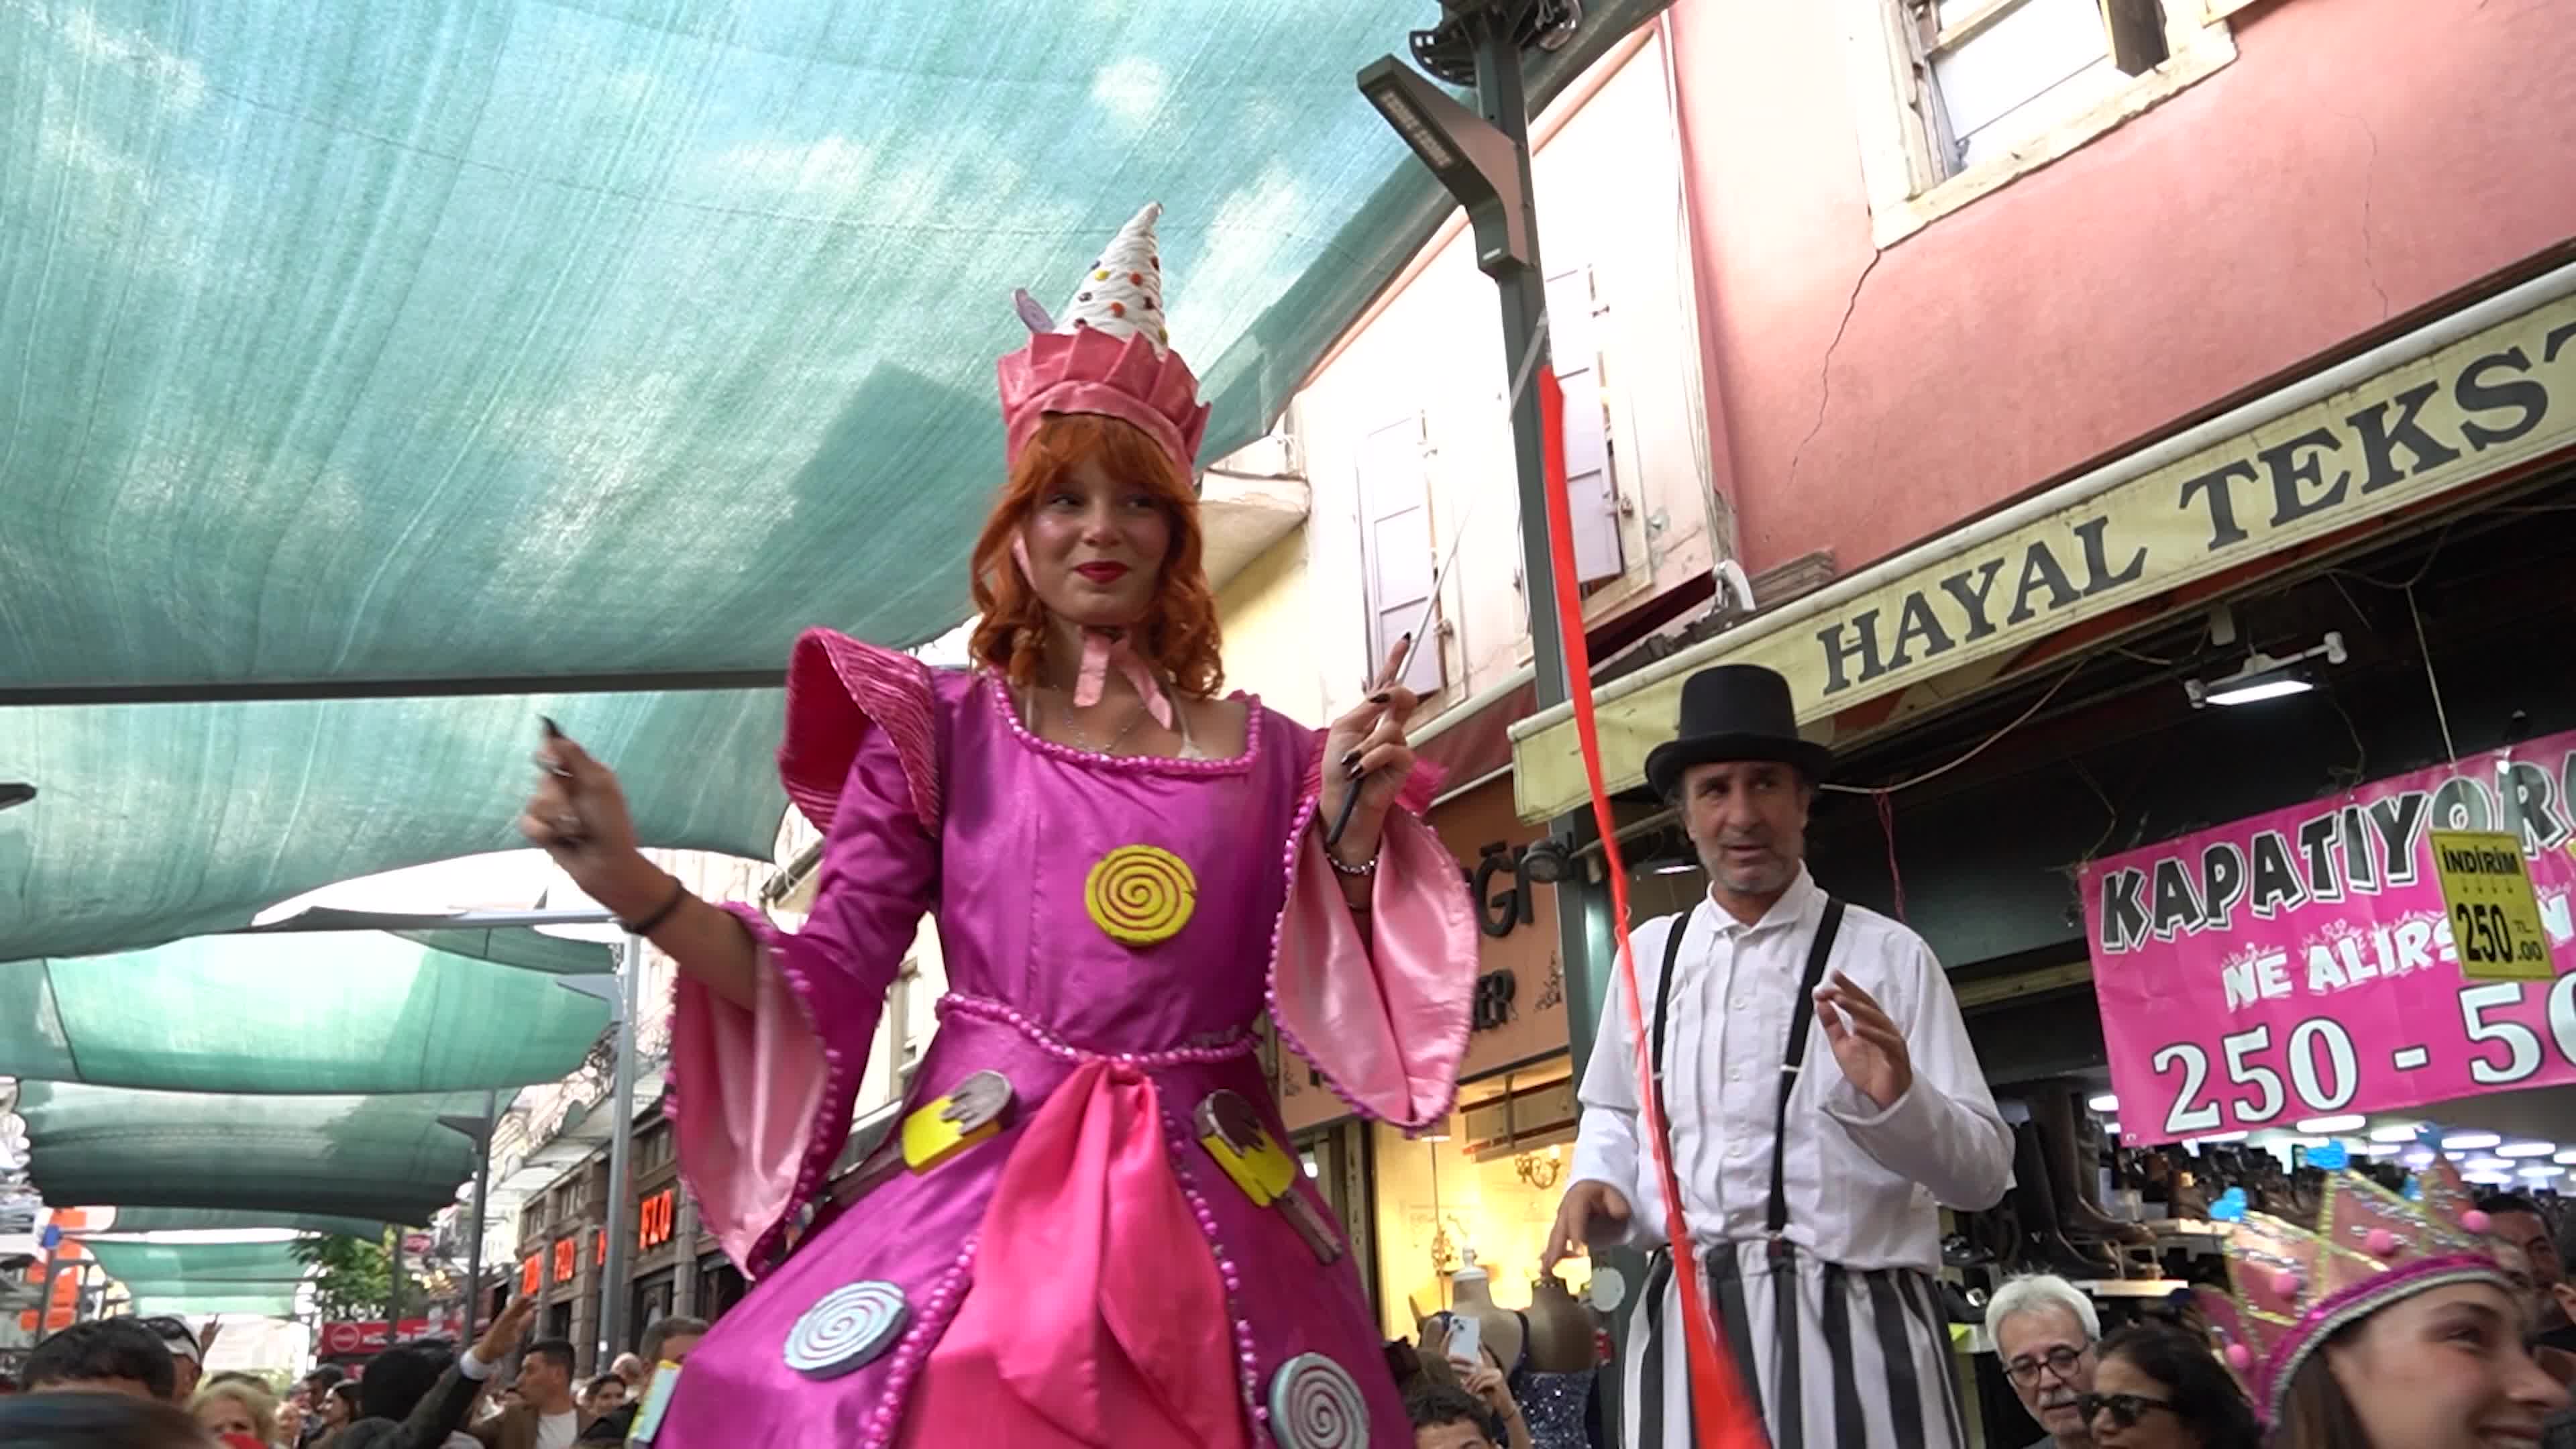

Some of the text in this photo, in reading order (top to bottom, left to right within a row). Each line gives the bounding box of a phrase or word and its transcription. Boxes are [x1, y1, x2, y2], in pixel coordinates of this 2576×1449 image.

[1817, 515, 2147, 696] HAYAL
[2100, 749, 2576, 954] KAPATIYOR
[2440, 843, 2522, 875] İNDİRİM
[2222, 892, 2575, 1013] NE ALIRSN
[2456, 902, 2514, 964] 250
[2151, 1016, 2359, 1135] 250
[2392, 1044, 2430, 1071] -
